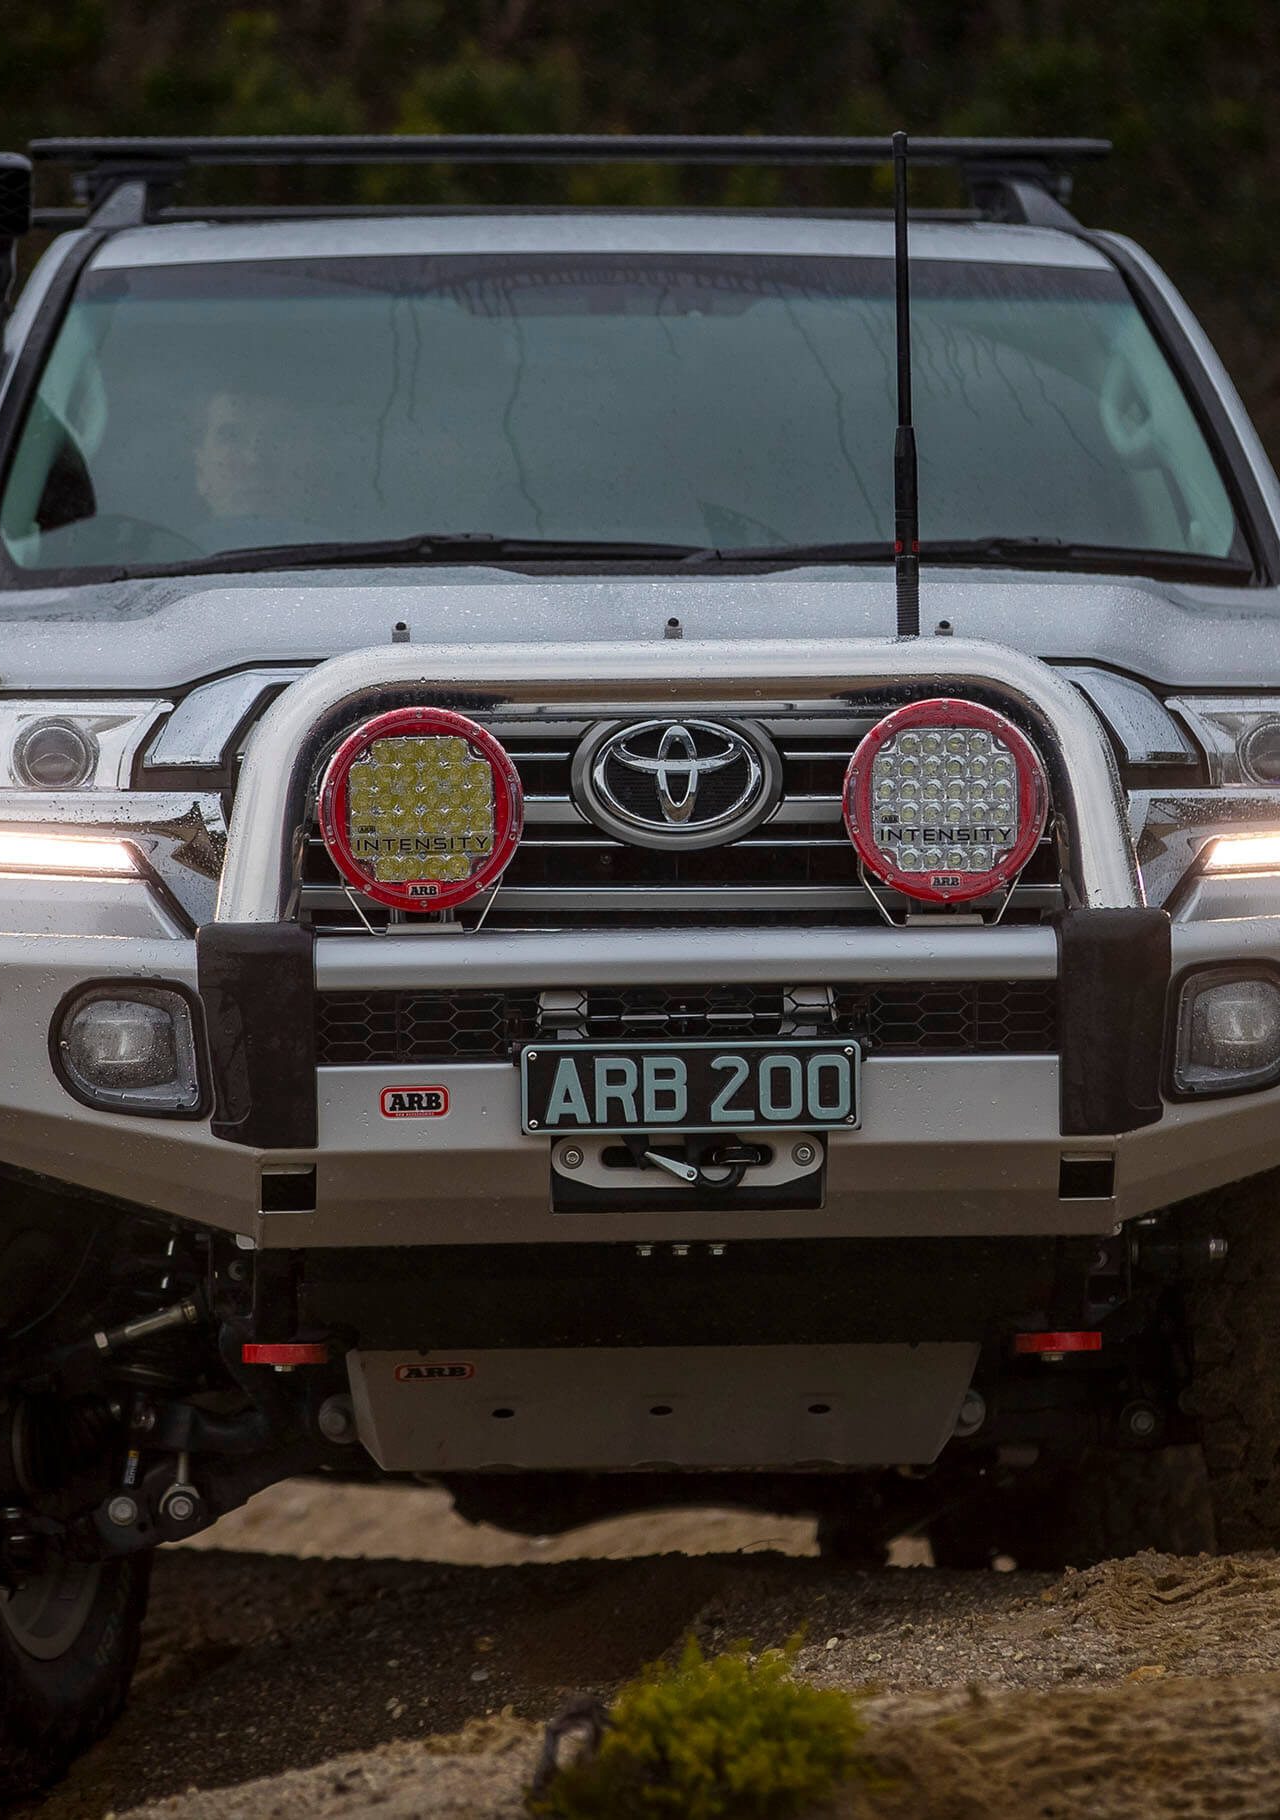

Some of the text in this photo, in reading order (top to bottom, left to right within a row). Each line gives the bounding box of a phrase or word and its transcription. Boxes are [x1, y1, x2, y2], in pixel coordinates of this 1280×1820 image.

[880, 828, 1012, 842] INTENSITY
[356, 836, 488, 852] INTENSITY
[932, 876, 960, 887] ARB
[410, 885, 438, 896] ARB
[545, 1053, 852, 1125] ARB 200
[389, 1092, 442, 1112] ARB
[403, 1366, 467, 1379] ARB
